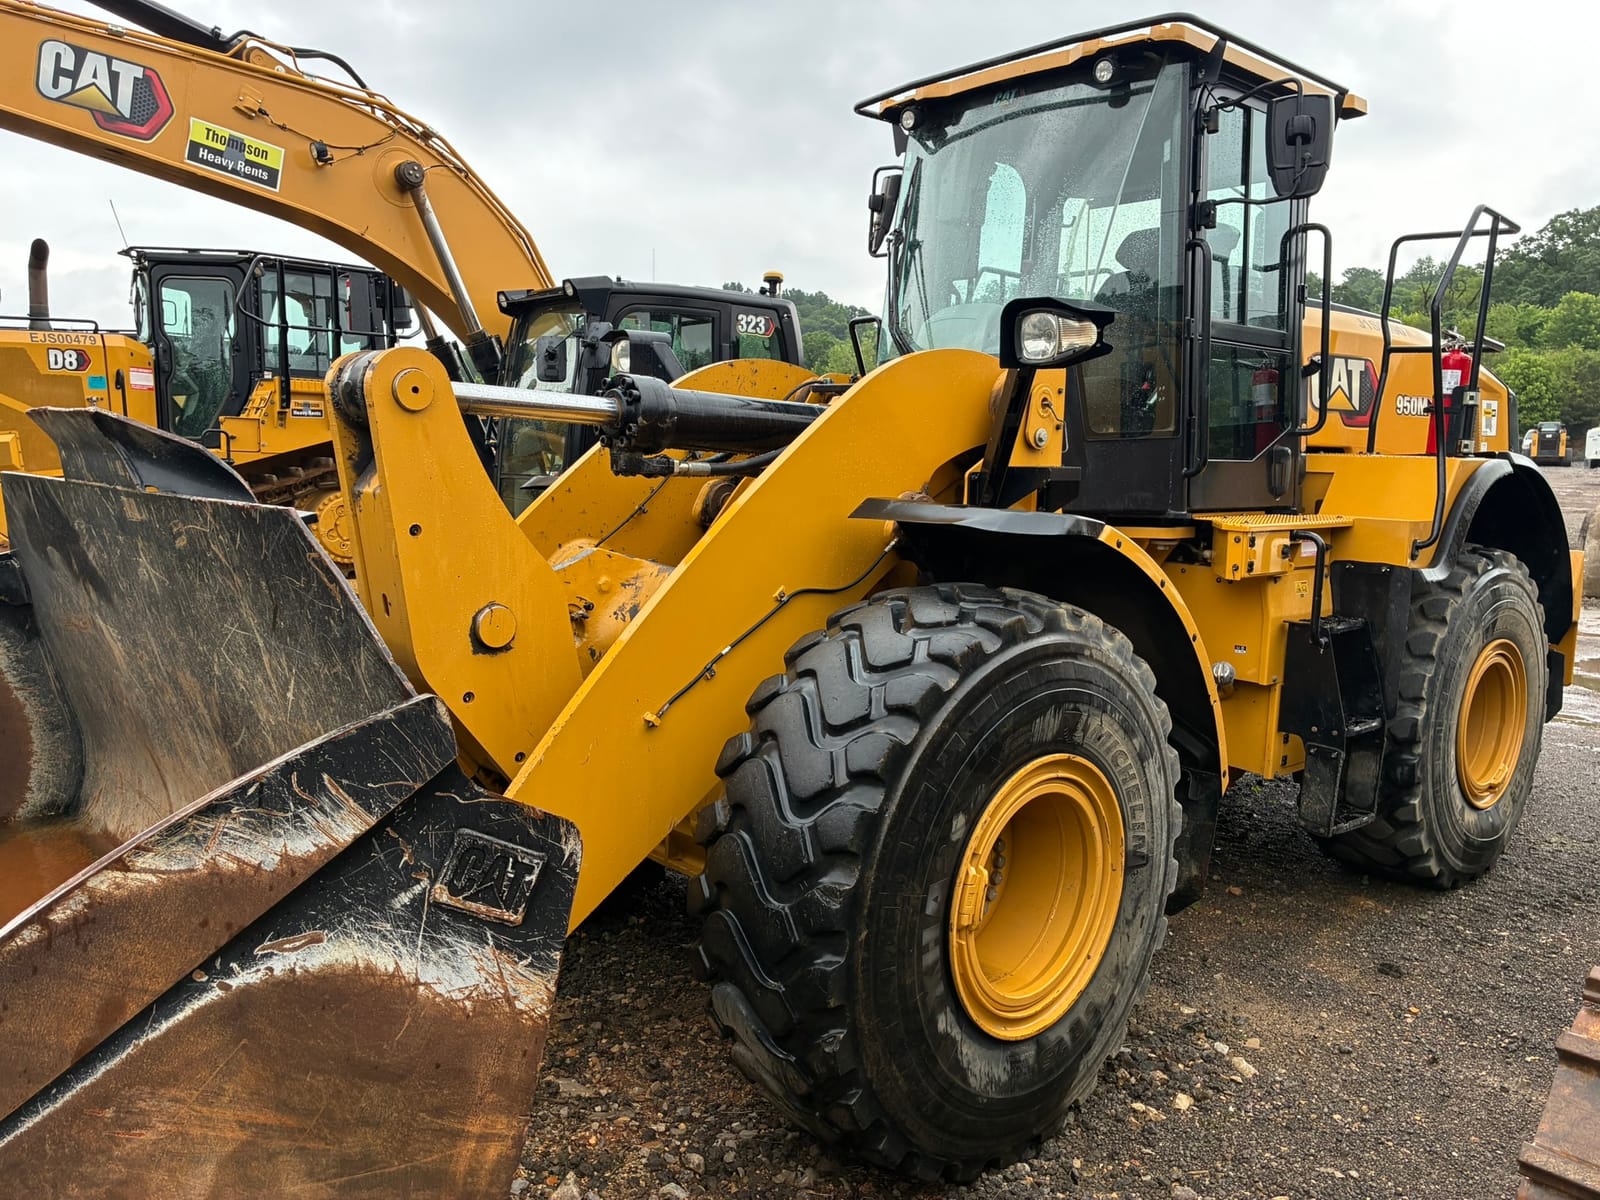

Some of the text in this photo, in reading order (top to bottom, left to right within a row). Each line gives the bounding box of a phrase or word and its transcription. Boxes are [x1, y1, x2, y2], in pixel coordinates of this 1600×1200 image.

[38, 41, 144, 119] CAT
[205, 127, 269, 160] Thompson
[199, 147, 269, 180] Heavy Rents
[29, 332, 97, 345] EJS00479
[737, 313, 766, 335] 323
[48, 348, 78, 370] D8
[1396, 395, 1430, 416] 950M
[1085, 719, 1147, 855] MICHELIN
[448, 846, 536, 911] CAT
